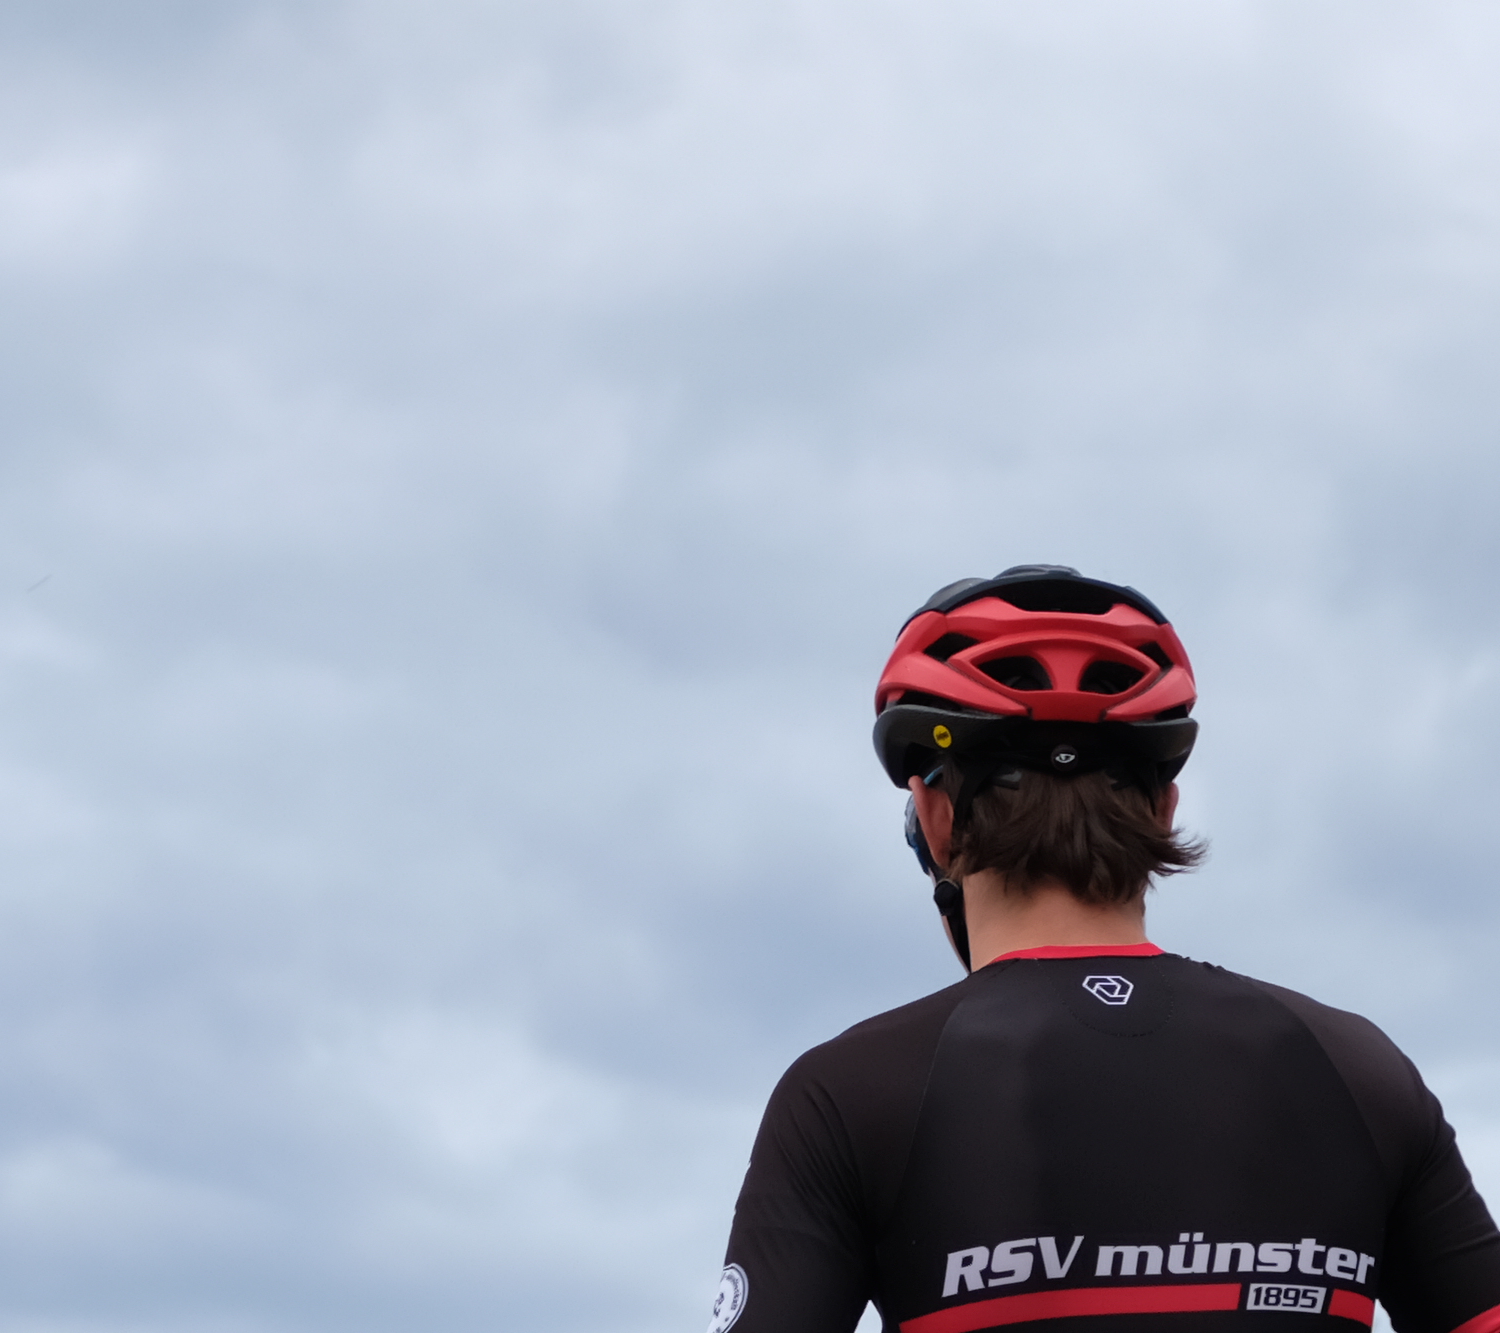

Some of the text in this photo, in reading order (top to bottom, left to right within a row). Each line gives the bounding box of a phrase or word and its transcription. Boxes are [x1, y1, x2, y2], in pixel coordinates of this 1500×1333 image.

[942, 1232, 1376, 1298] RSV münster
[1252, 1285, 1322, 1310] 1895
